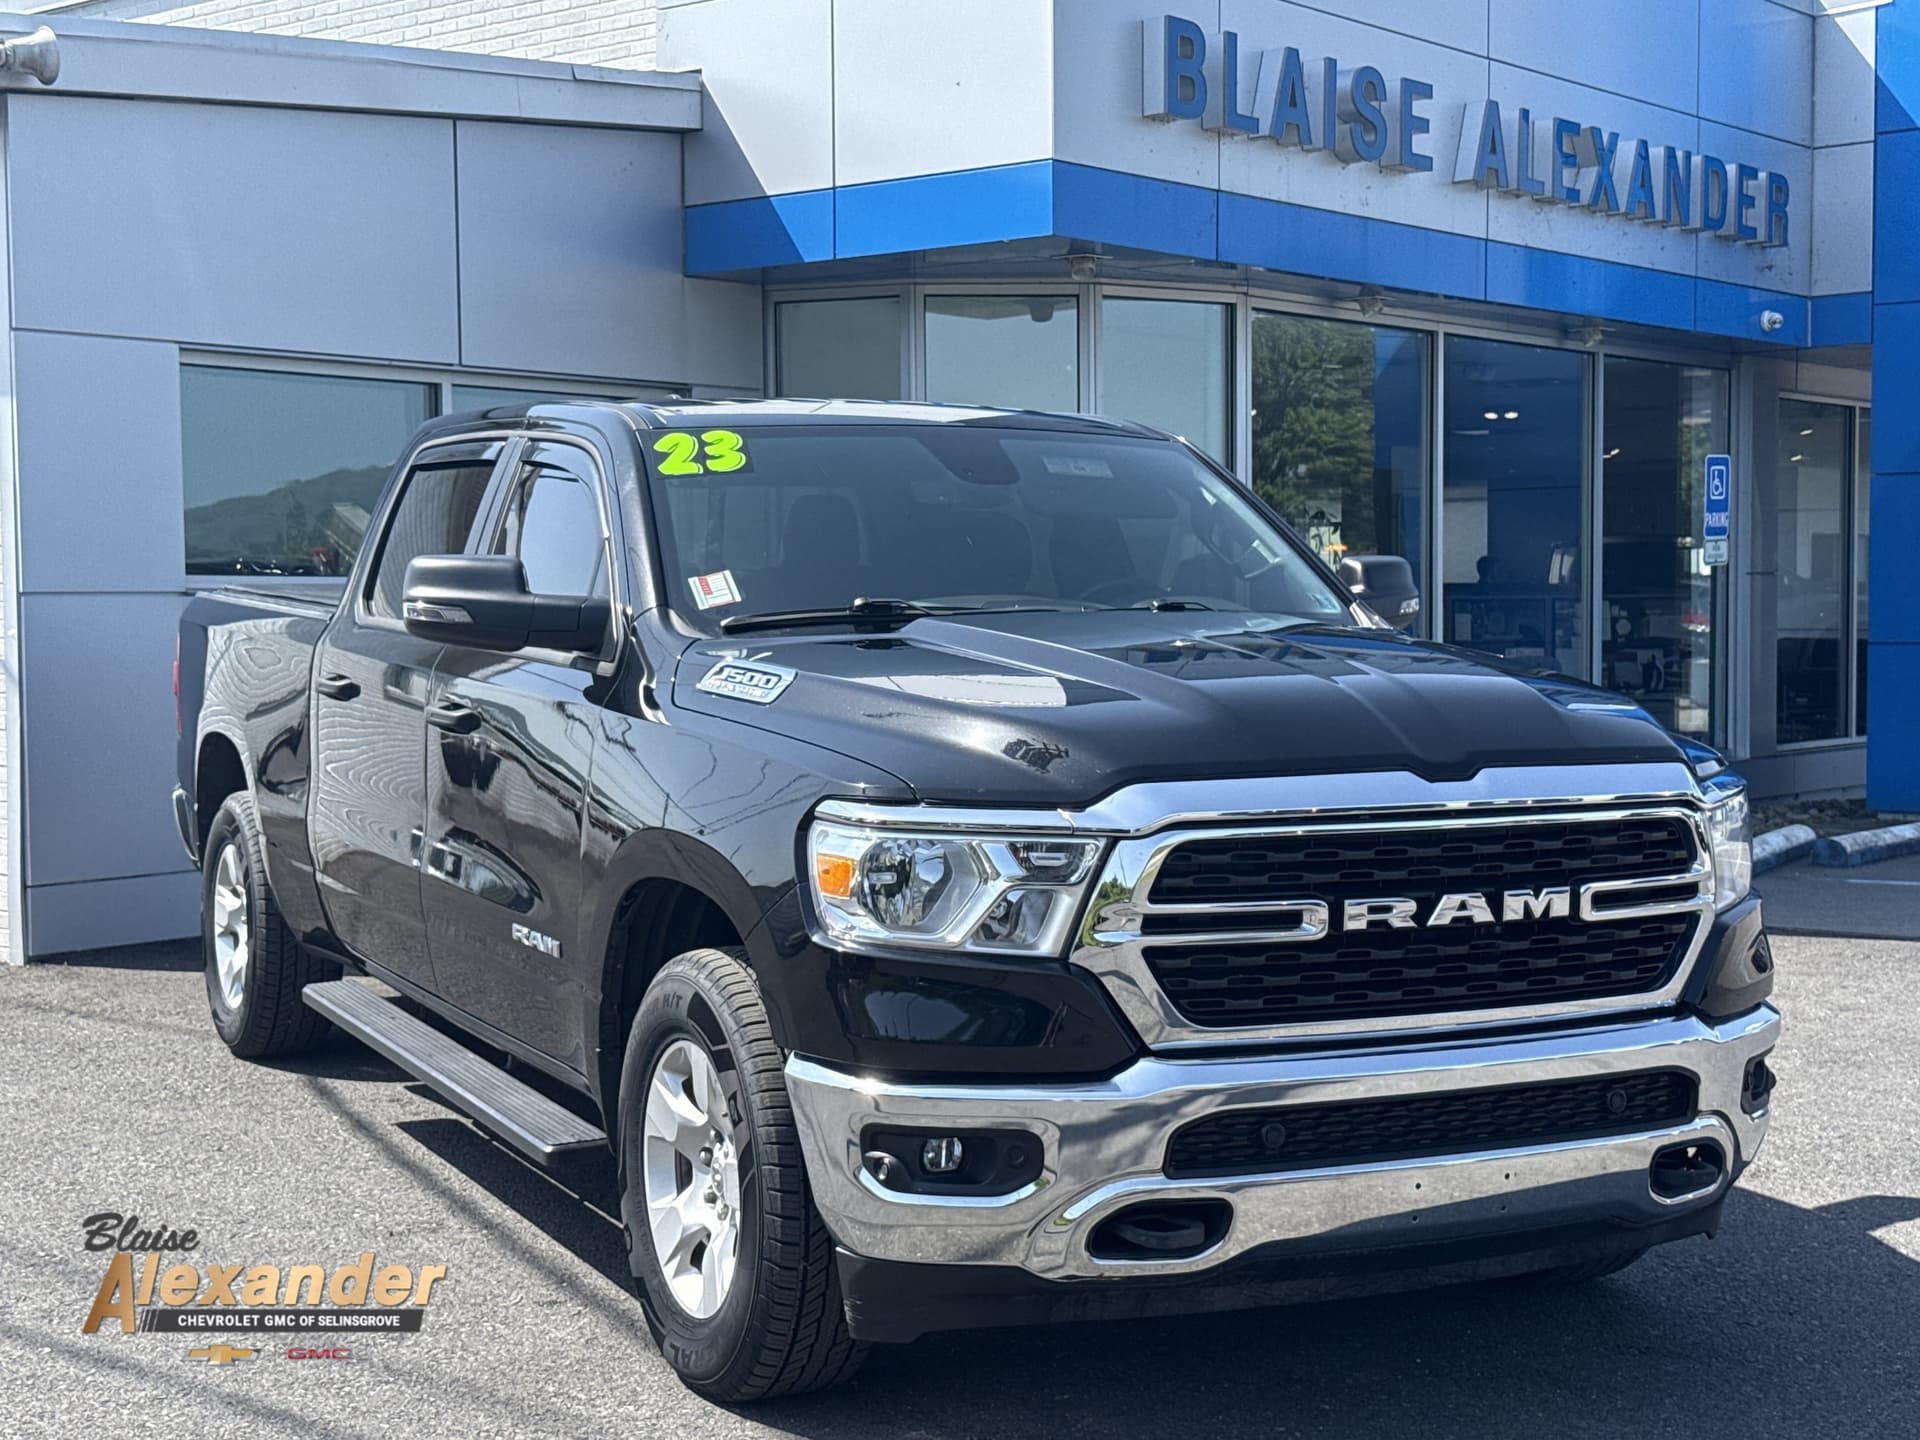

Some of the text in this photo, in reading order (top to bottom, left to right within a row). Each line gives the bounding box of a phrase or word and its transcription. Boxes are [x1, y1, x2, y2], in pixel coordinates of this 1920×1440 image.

[1163, 14, 1791, 247] BLAISE ALEXANDER
[653, 430, 747, 475] 23
[714, 667, 780, 689] 1500
[1343, 886, 1571, 931] RAM
[511, 922, 562, 959] RAM
